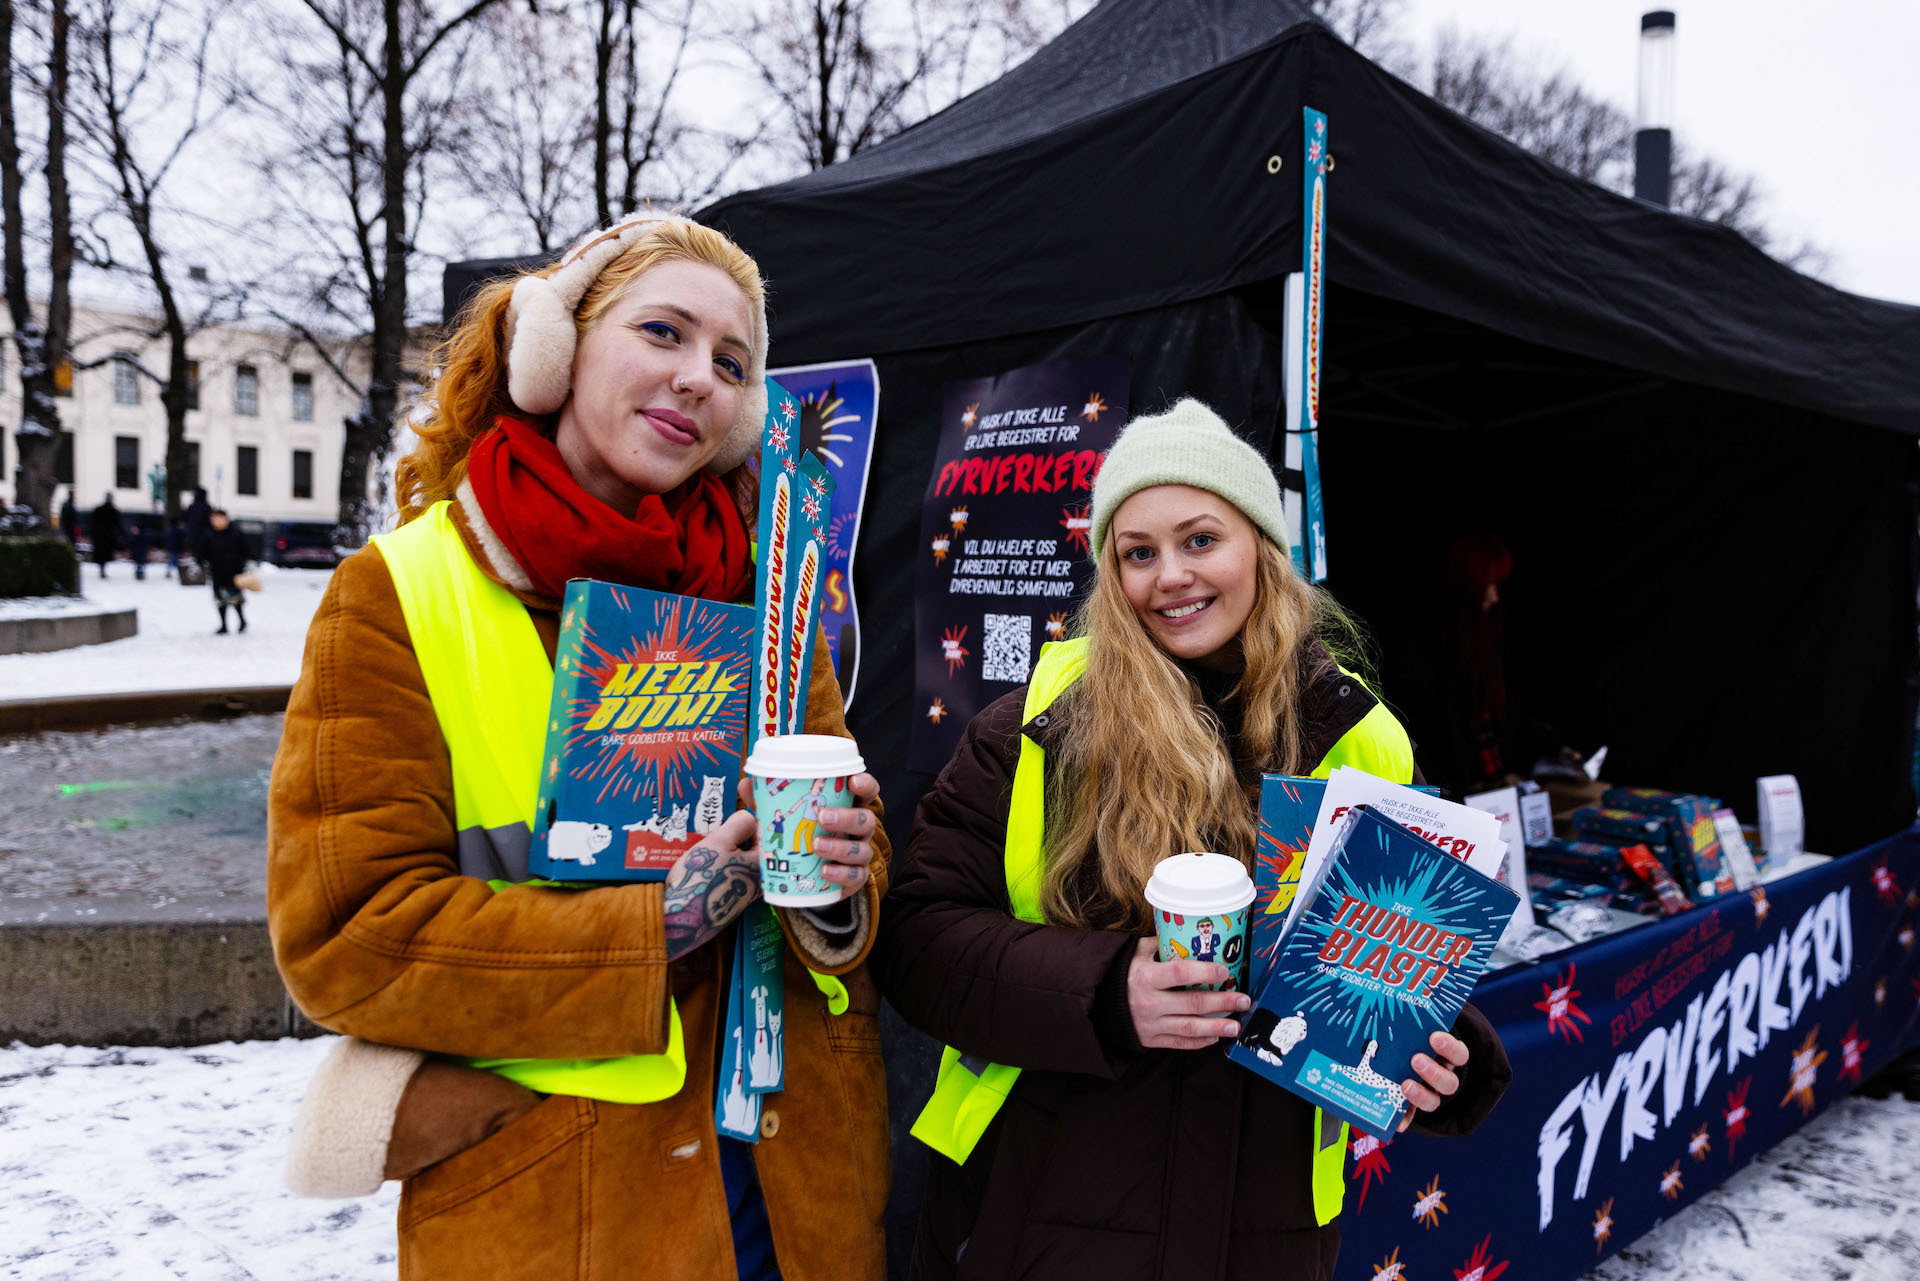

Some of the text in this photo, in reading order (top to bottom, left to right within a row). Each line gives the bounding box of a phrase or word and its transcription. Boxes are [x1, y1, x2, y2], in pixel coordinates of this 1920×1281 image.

[979, 414, 1000, 430] HUSK
[1000, 410, 1013, 427] AT
[1013, 408, 1039, 425] IKKE
[1039, 405, 1067, 423] ALLE
[964, 425, 1080, 451] ER LIKE BEGEISTRET FOR
[964, 539, 979, 556] VIL
[981, 539, 996, 556] DU
[996, 539, 1035, 556] HJELPE
[1036, 539, 1057, 556] OSS
[953, 558, 1071, 576] I ARBEIDET FOR ET MER
[949, 578, 1074, 597] DYREVENNLIG SAMFUNN?
[655, 650, 678, 661] IKKE
[601, 661, 741, 696] MEGA
[583, 693, 728, 731] BOOM!
[601, 730, 726, 746] BARE GODBITER TIL KATTEN
[1380, 806, 1395, 816] LIKE
[1395, 810, 1434, 827] BEGEISTRET
[1433, 820, 1446, 830] FOR
[1381, 798, 1398, 808] HUSK
[1408, 804, 1424, 815] IKKE
[1424, 809, 1440, 819] ALLE
[1391, 902, 1414, 916] IKKE
[1331, 894, 1474, 968] THUNDER
[1317, 927, 1449, 999] BLAST!
[1317, 964, 1433, 1009] BARE GODBITER TIL HUNDEN
[1537, 886, 1852, 1233] FYRVERKERI
